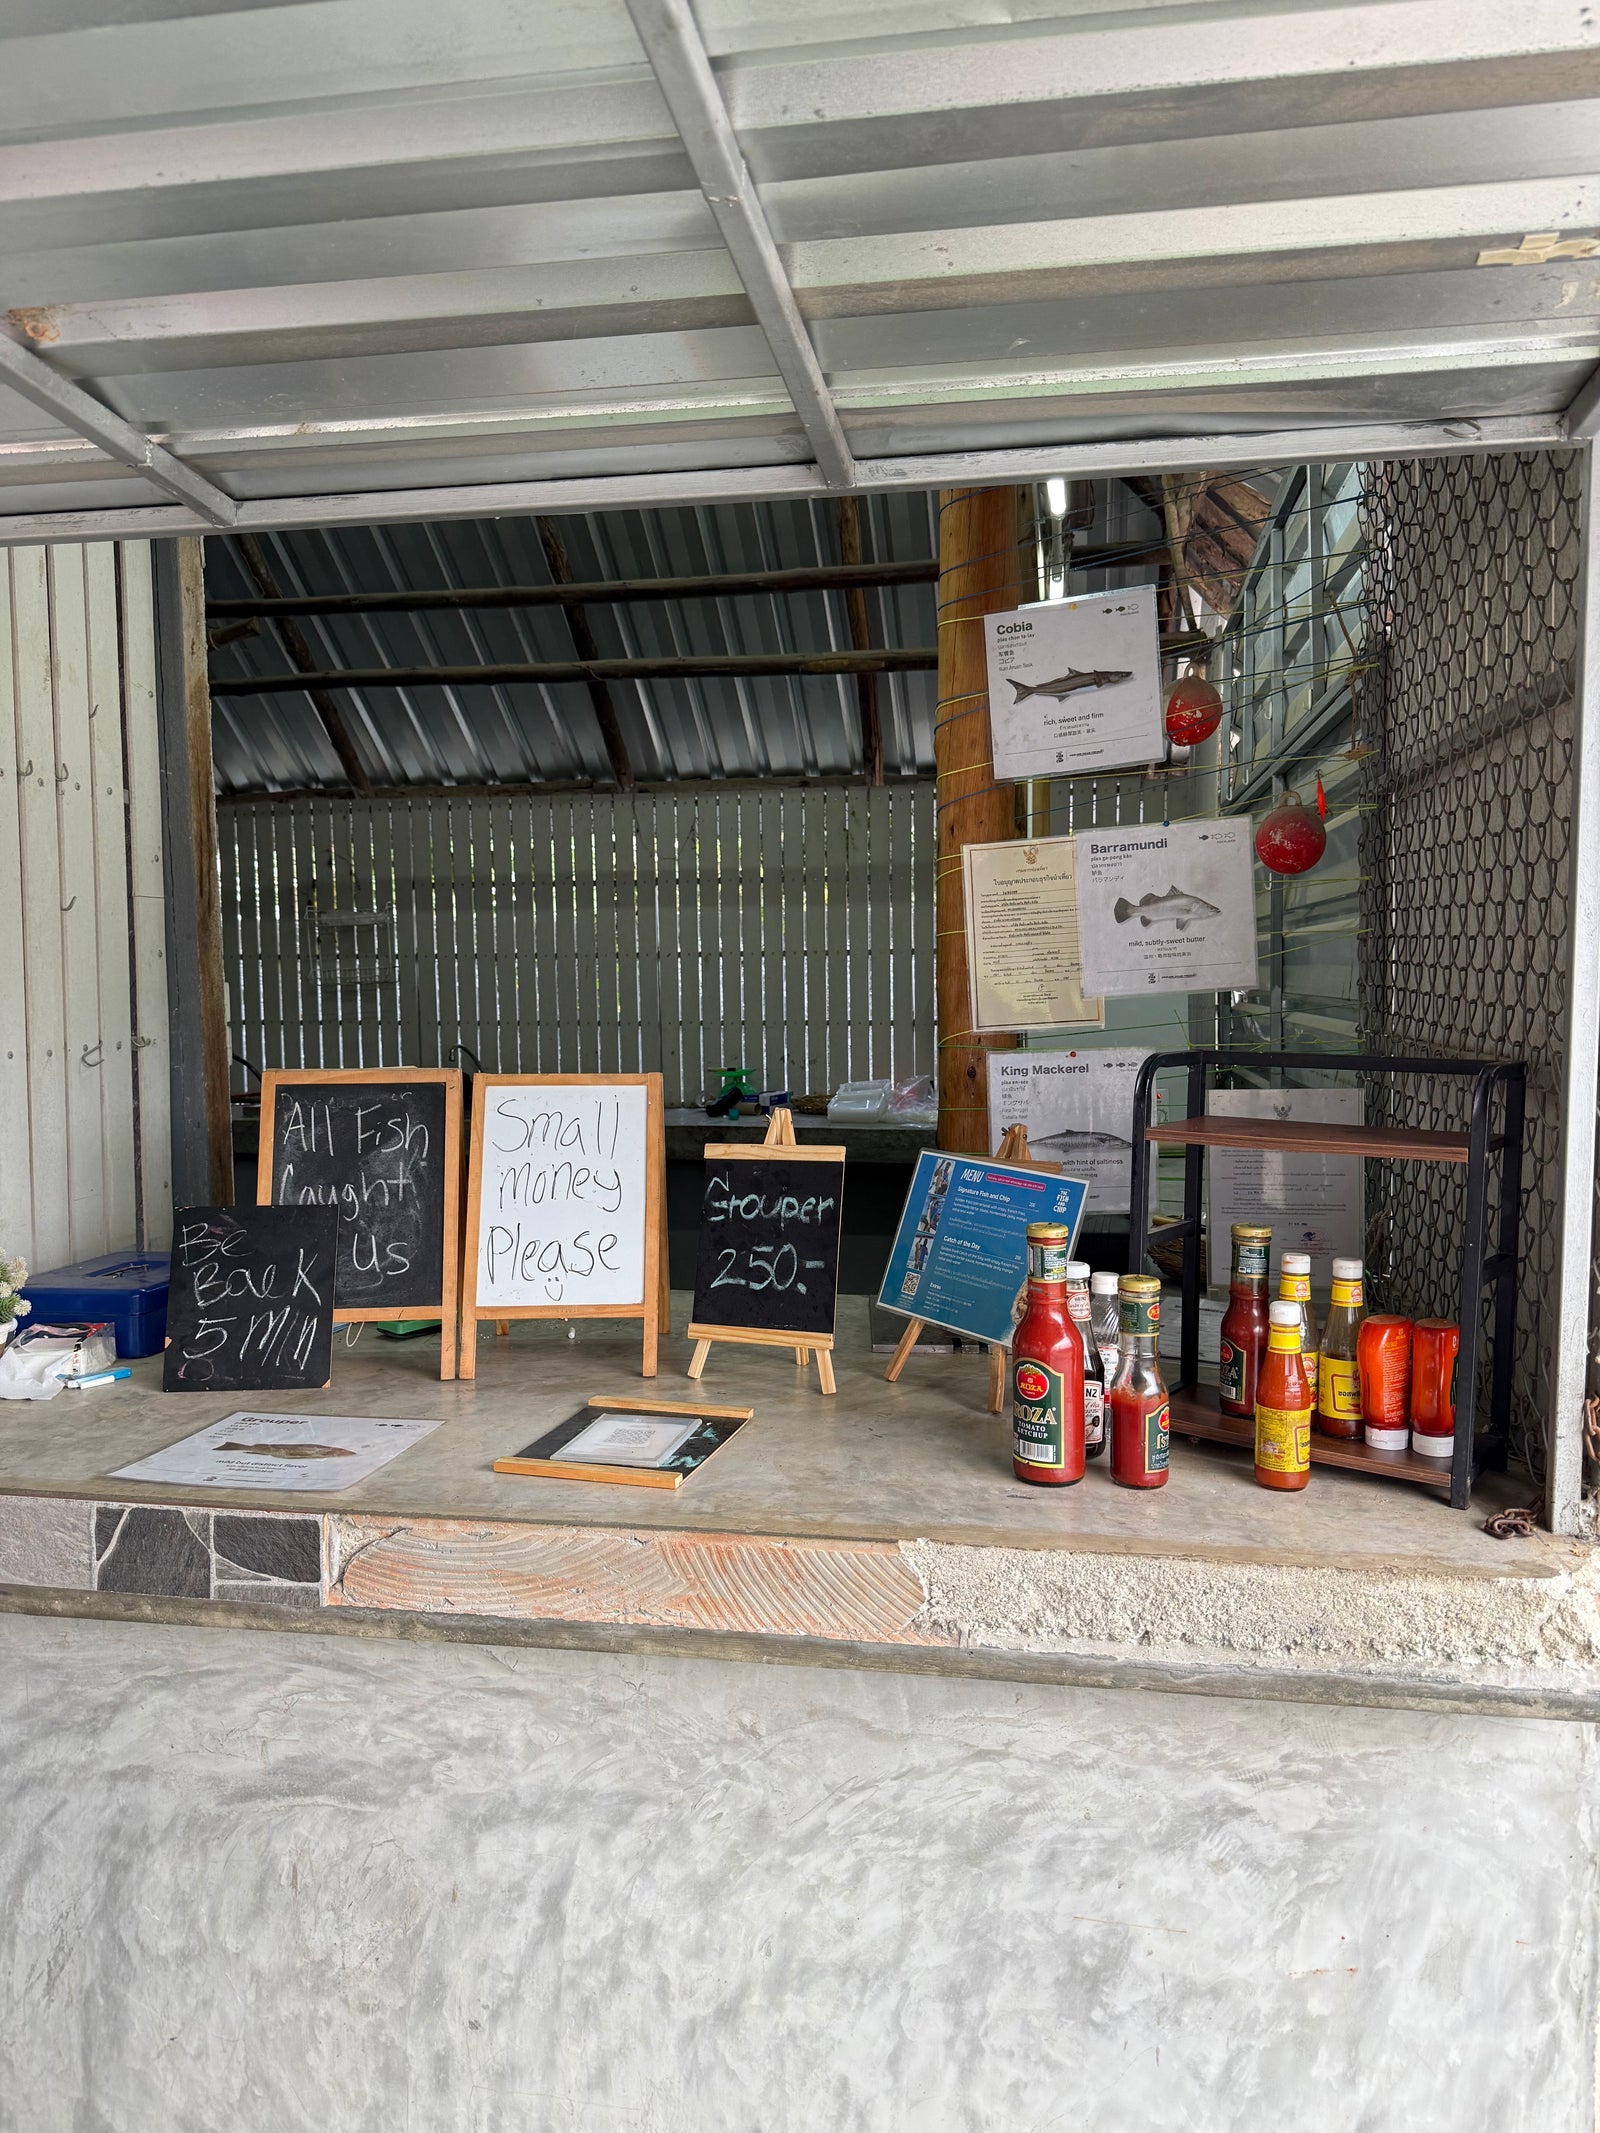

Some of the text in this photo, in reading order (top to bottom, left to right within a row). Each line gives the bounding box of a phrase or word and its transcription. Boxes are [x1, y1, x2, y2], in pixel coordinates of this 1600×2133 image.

[996, 621, 1033, 635] Cobia
[1058, 716, 1077, 724] sweet
[1090, 838, 1168, 855] Barramundi
[1145, 938, 1185, 946] subtly-sweet
[1001, 1063, 1089, 1077] King Mackerel
[283, 1101, 430, 1159] All Fish
[492, 1097, 620, 1160] Small
[960, 1167, 985, 1183] MENU
[704, 1170, 834, 1231] Grouper
[957, 1185, 1011, 1203] Signature Fish and Chip
[1056, 1194, 1070, 1203] FISH
[1053, 1205, 1067, 1214] CHIP
[179, 1222, 252, 1267] Be
[943, 1235, 957, 1244] Catch
[971, 1241, 981, 1251] Day
[710, 1242, 825, 1295] 250.-
[182, 1317, 238, 1359] 5
[1019, 1382, 1044, 1392] ROZA
[240, 1416, 310, 1425] Grouper
[1013, 1400, 1058, 1425] ROZA
[1017, 1426, 1049, 1439] KETCHUP
[1018, 1420, 1046, 1432] TOMATO
